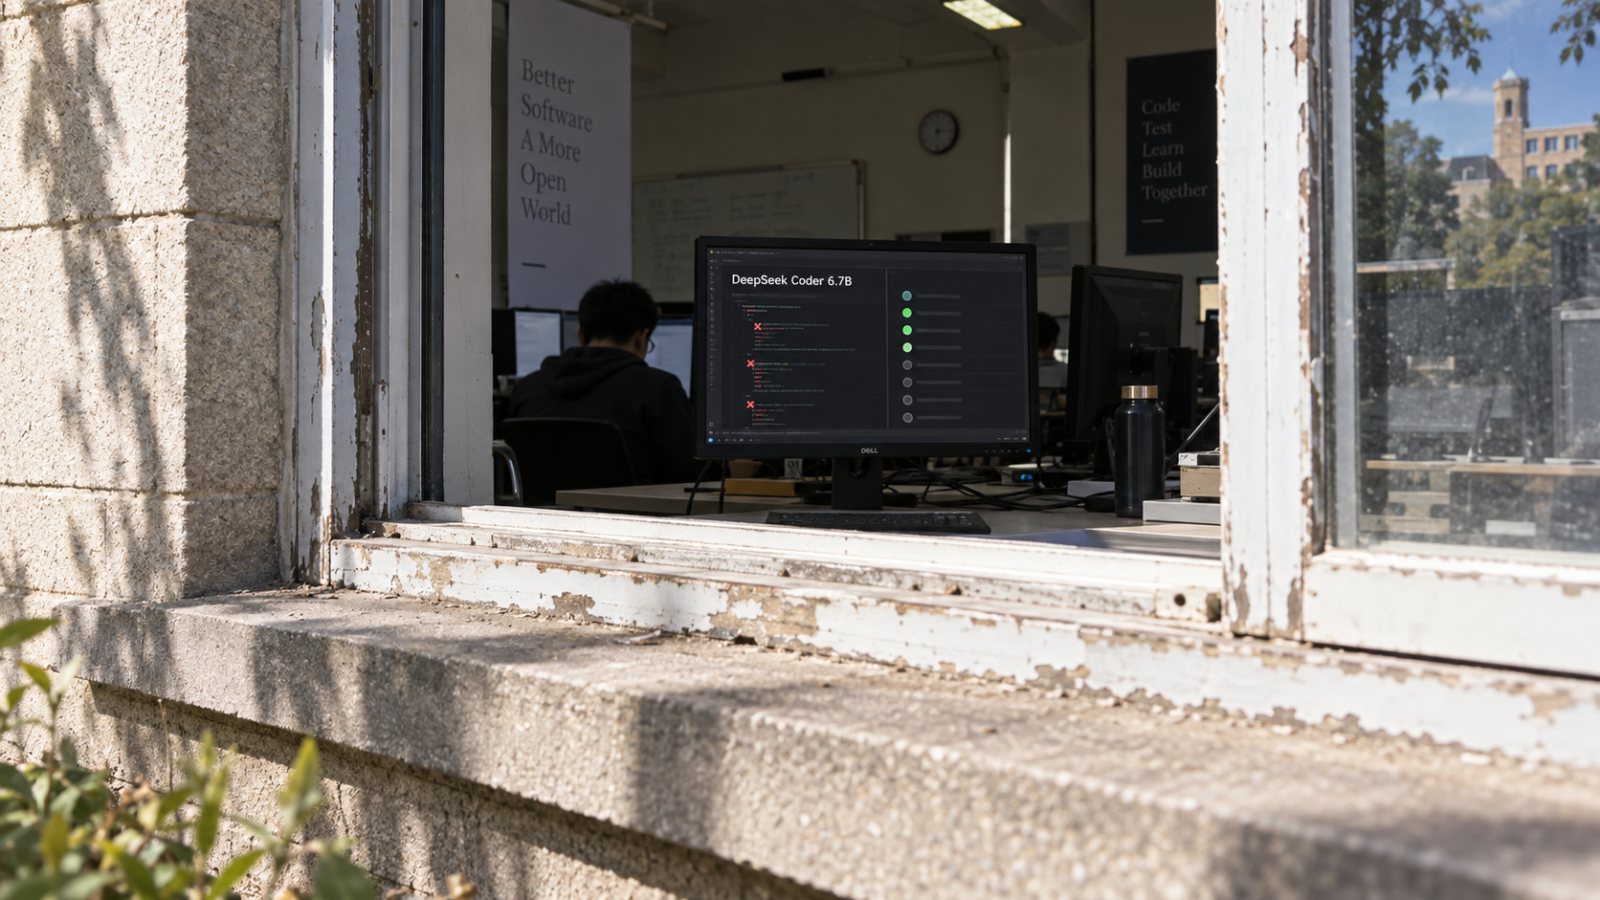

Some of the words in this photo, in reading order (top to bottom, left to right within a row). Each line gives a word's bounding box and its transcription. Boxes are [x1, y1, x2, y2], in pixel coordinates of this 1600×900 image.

[521, 58, 575, 94] Better
[521, 93, 593, 133] Software
[1141, 97, 1181, 115] Code
[1141, 121, 1173, 136] Test
[520, 129, 534, 152] A
[539, 132, 582, 163] More
[1142, 143, 1184, 158] Learn
[520, 162, 567, 194] Open
[1142, 161, 1182, 179] Build
[1141, 182, 1208, 204] Together
[520, 197, 571, 226] World
[732, 274, 788, 287] DeepSeek
[791, 275, 824, 286] Coder
[827, 276, 853, 286] 6.7B
